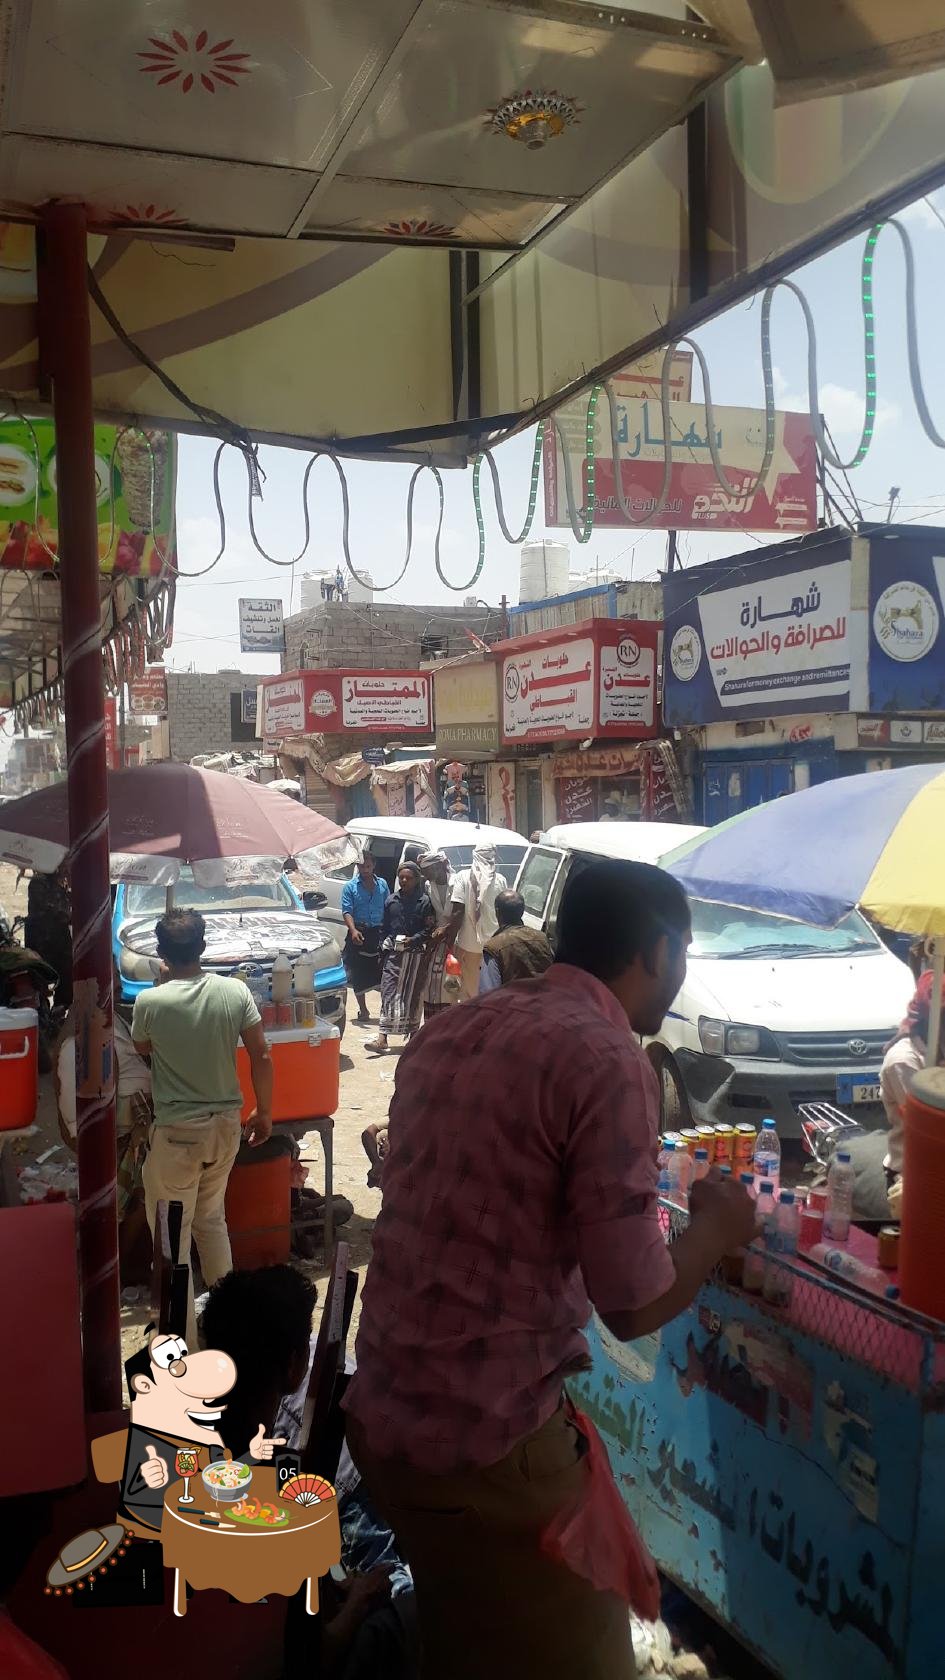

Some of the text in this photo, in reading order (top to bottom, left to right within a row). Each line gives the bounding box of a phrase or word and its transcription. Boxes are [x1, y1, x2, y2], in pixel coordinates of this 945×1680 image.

[710, 617, 846, 660] للصرافة والحوالات
[620, 645, 637, 657] RN
[506, 675, 517, 690] RN
[773, 676, 801, 685] exchange
[344, 680, 426, 702] الممتاز
